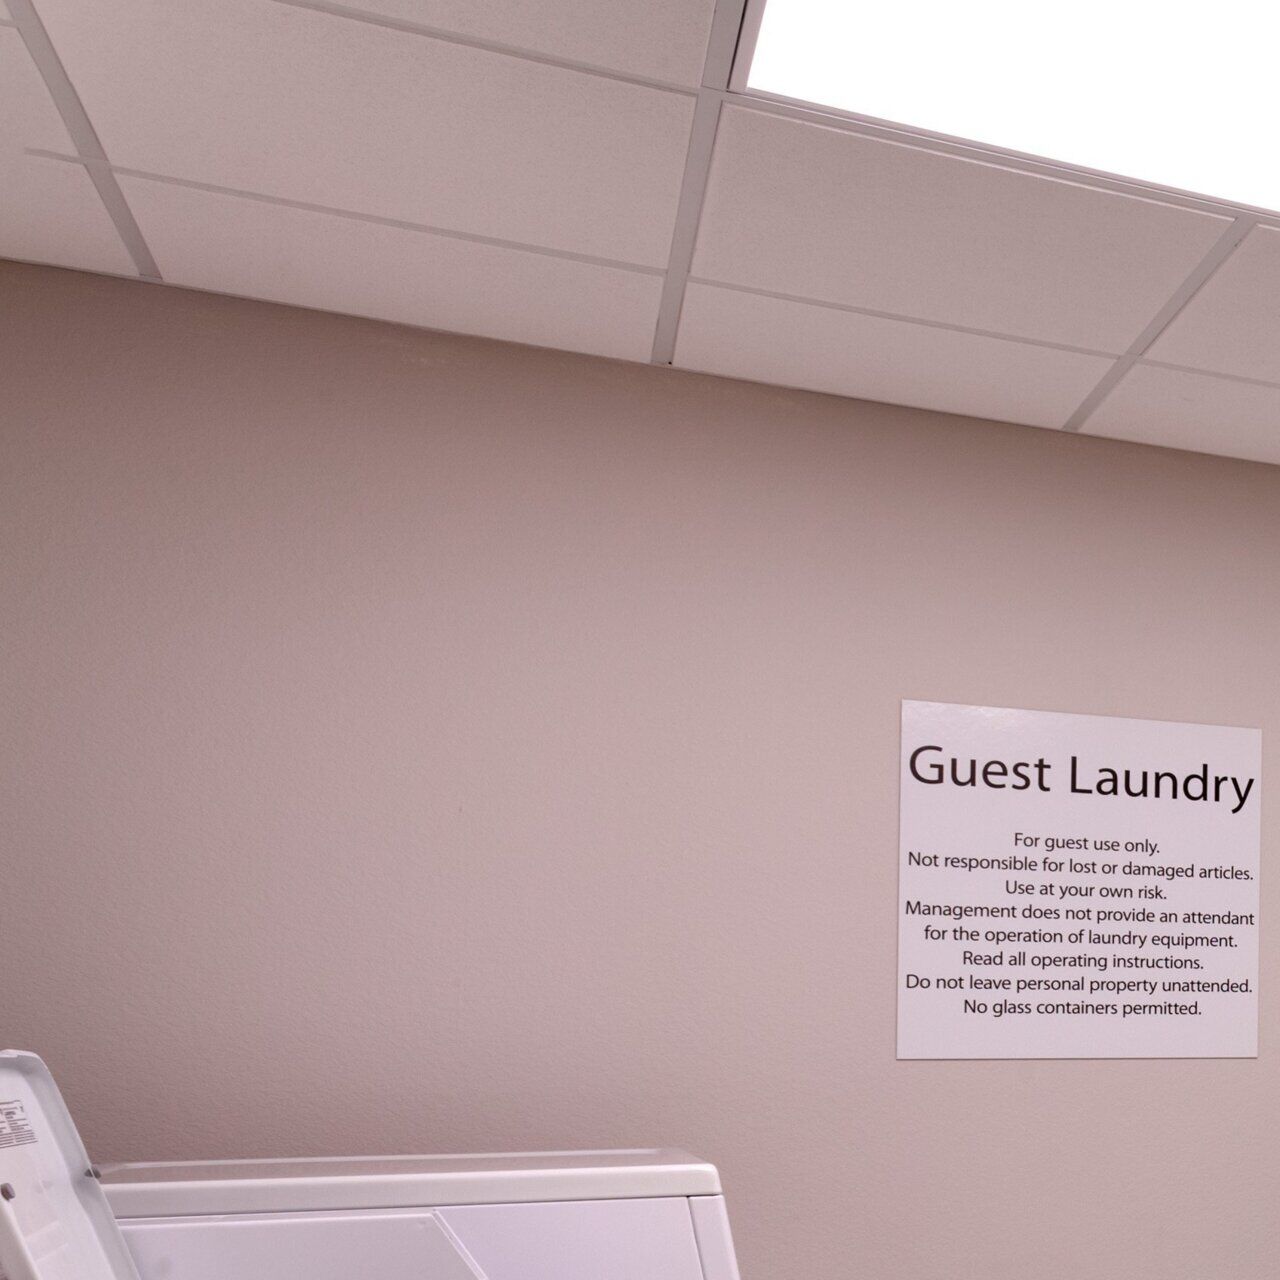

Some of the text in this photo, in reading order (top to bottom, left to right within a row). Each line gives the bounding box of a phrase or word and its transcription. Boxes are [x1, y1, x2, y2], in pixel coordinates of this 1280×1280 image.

[909, 744, 1254, 814] Guest Laundry
[1014, 832, 1159, 856] For guest use only.
[908, 851, 1253, 880] Not responsible for lost or damaged articles.
[1005, 879, 1166, 899] Use at your own risk.
[905, 900, 1254, 925] Management does not provide an attendant
[923, 924, 1237, 949] for the operation of laundry equipment.
[962, 950, 1203, 971] Read all operating instructions.
[906, 973, 1252, 995] Do not leave personal property unattended.
[963, 998, 1201, 1018] No glass containers permitted.
